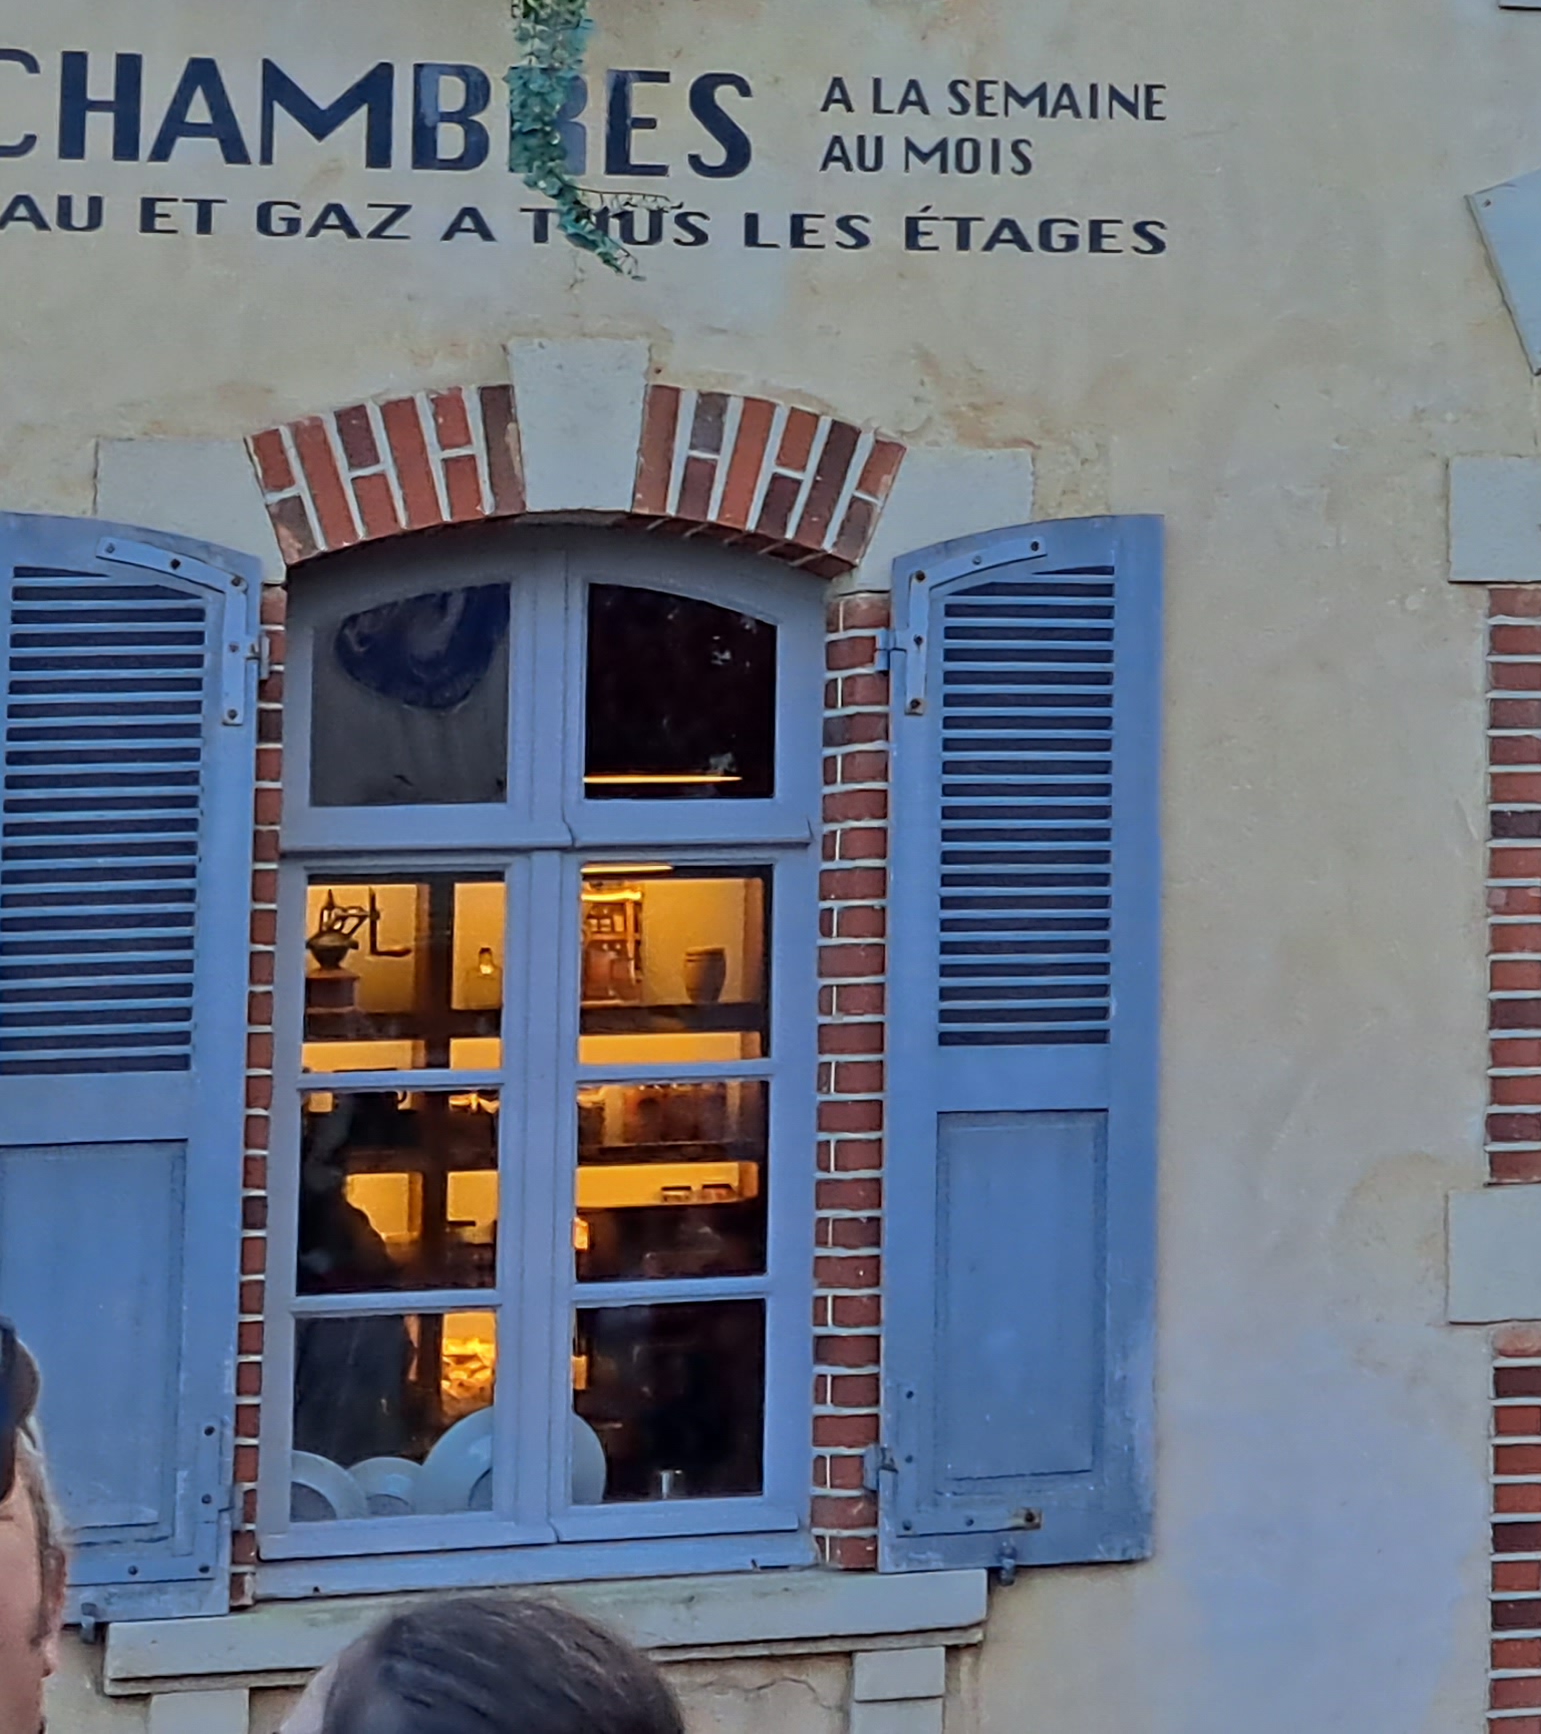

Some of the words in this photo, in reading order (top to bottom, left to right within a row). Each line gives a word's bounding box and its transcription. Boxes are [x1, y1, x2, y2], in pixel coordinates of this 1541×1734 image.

[820, 76, 855, 113] A
[871, 77, 931, 115] LA
[947, 79, 1168, 122] SEMAINE
[819, 134, 885, 173] AU
[904, 135, 1034, 176] MOIS
[139, 196, 228, 236] ET
[256, 200, 413, 240] GAZ
[440, 206, 497, 243] A
[743, 211, 872, 250] LES
[904, 204, 1168, 255] ÉTAGES
